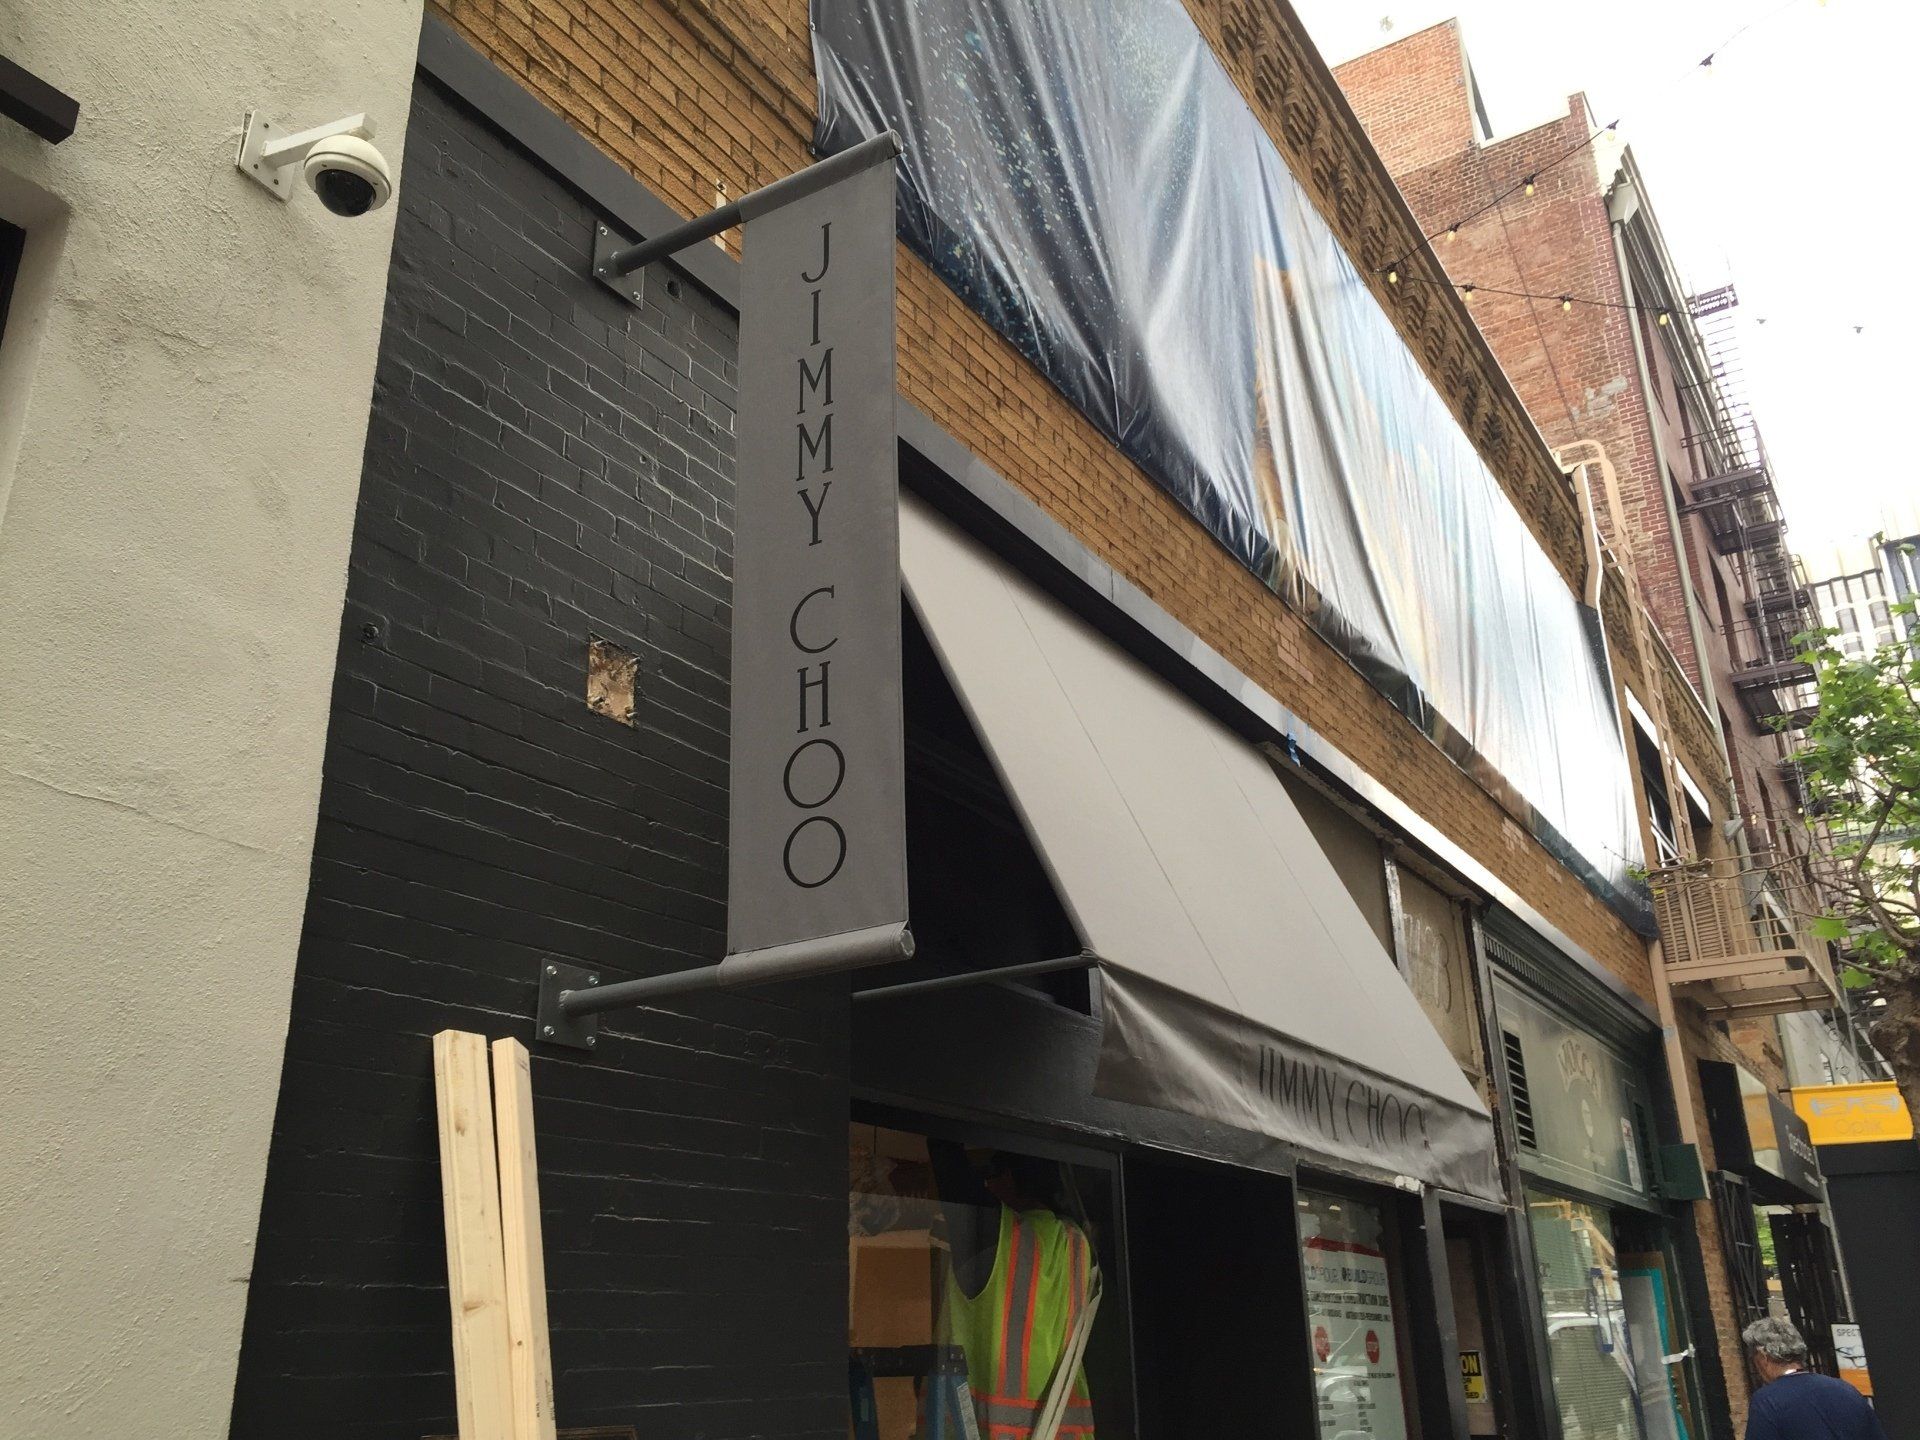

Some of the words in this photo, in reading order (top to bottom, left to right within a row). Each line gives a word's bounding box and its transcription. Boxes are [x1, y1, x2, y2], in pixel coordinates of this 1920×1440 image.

[796, 221, 834, 547] JIMMY
[782, 584, 847, 889] CHOO
[1345, 1079, 1431, 1152] CHOO
